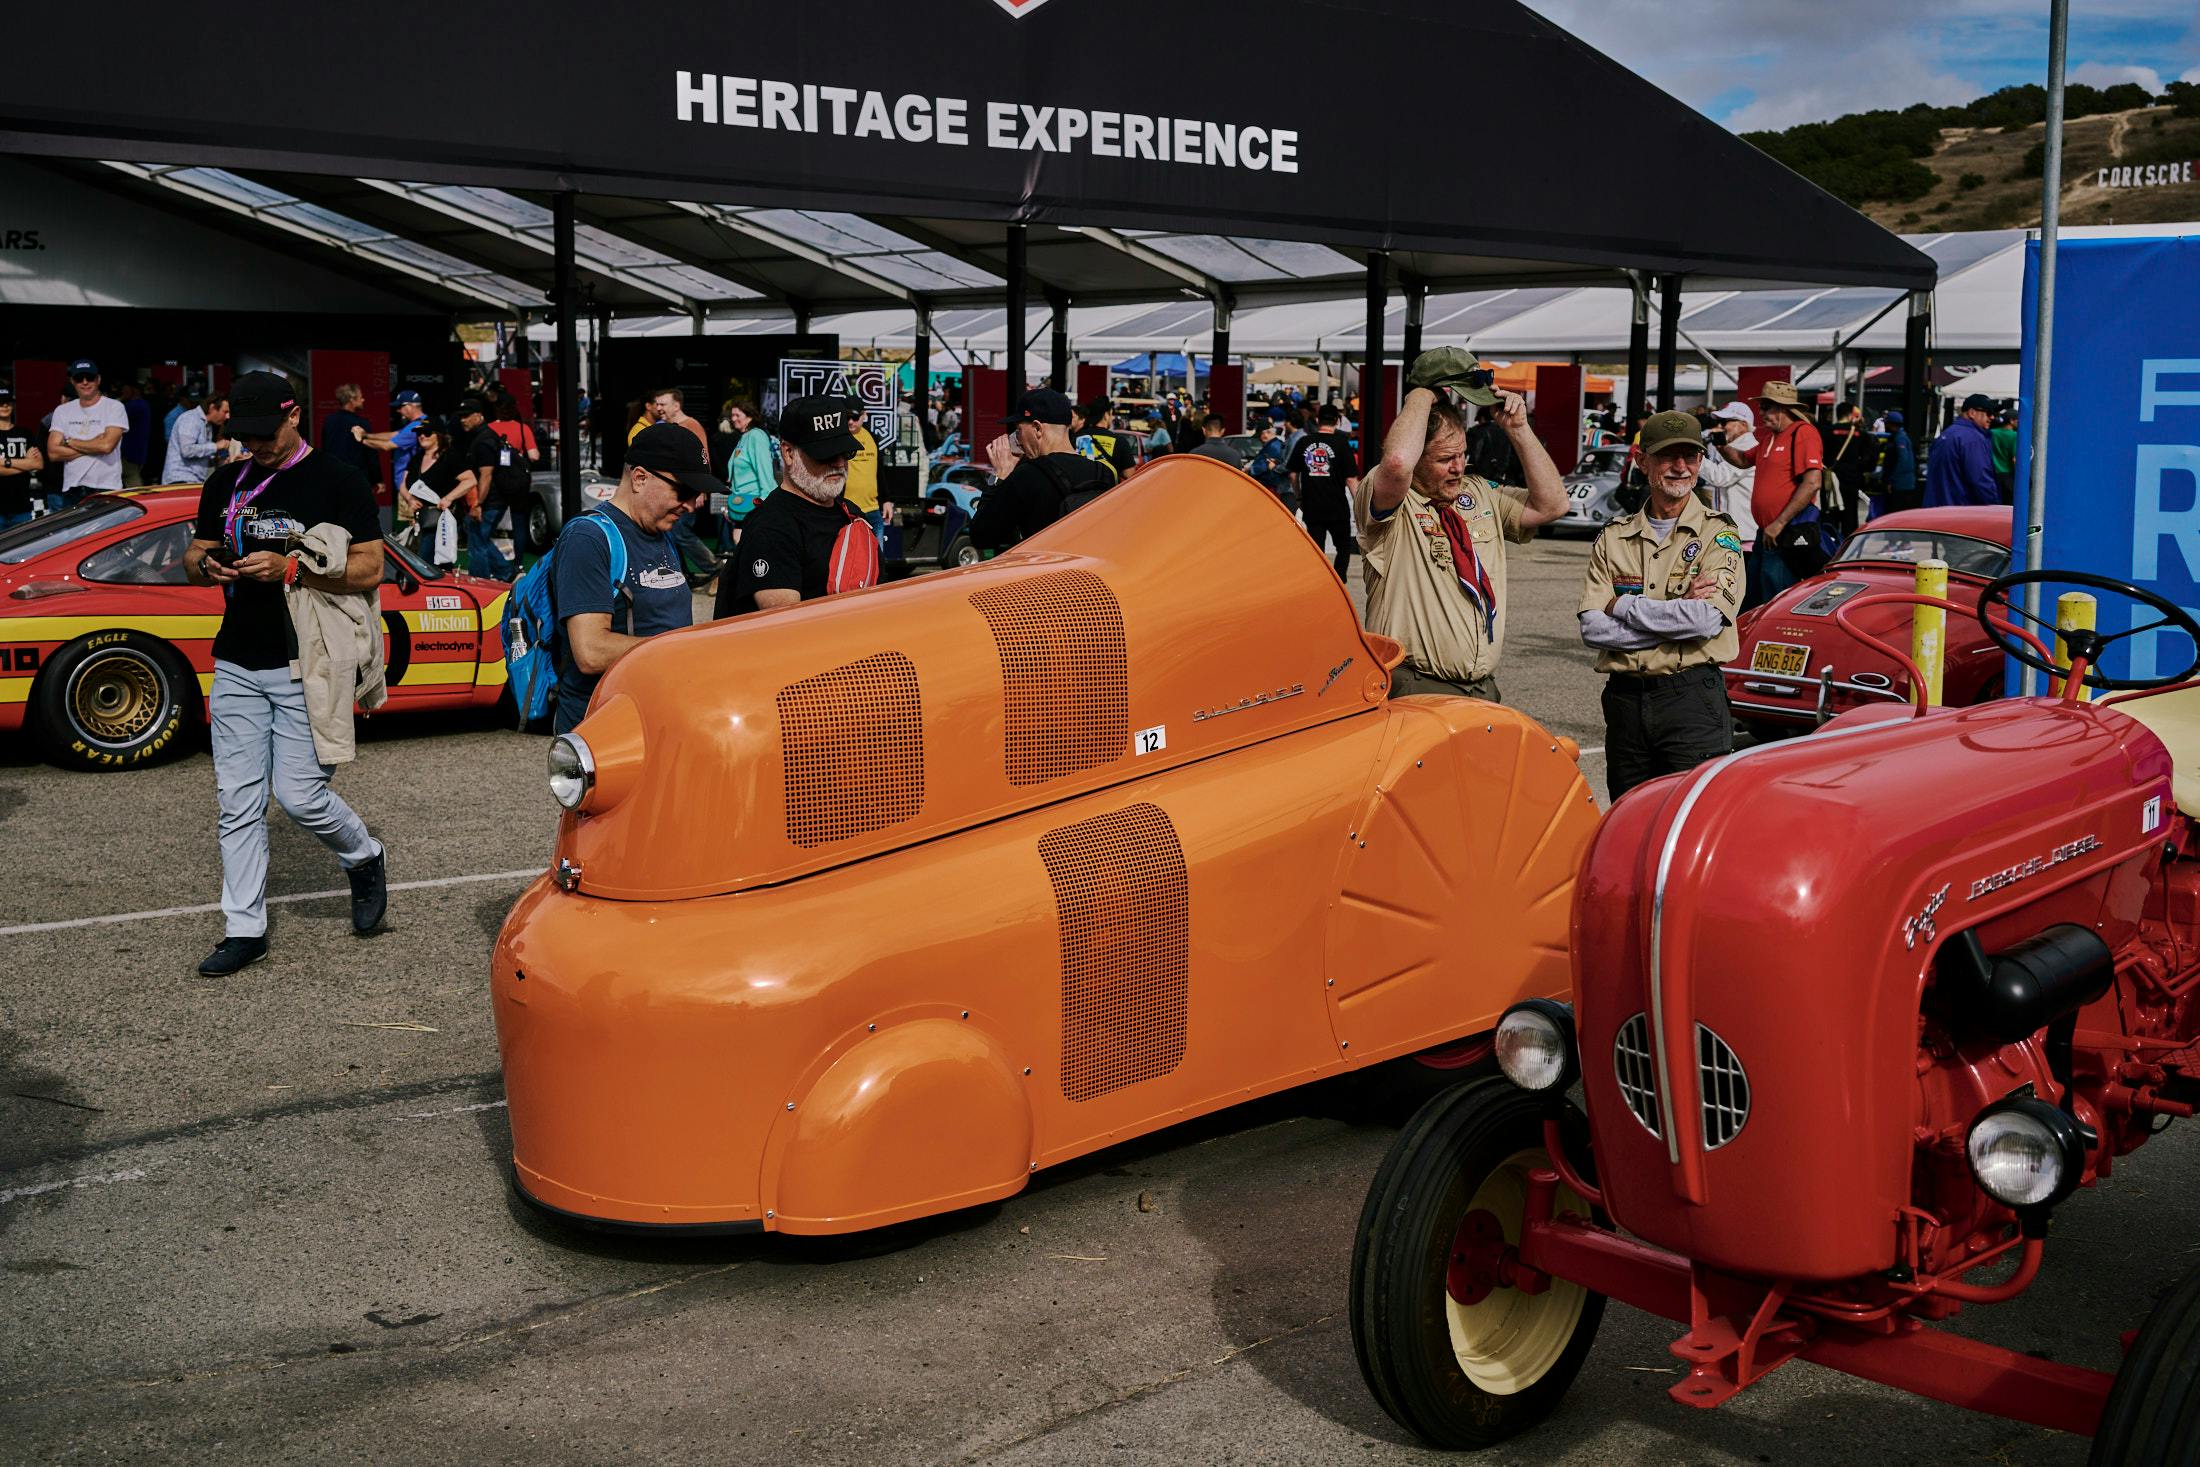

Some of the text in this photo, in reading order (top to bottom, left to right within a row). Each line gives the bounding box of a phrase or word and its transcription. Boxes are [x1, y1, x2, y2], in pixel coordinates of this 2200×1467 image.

[677, 70, 1298, 173] HERITAGE EXPERIENCE
[2098, 161, 2200, 188] CORKSCRE
[0, 230, 46, 250] RS.
[791, 368, 886, 404] TAG
[813, 411, 842, 432] RR7
[1566, 484, 1592, 499] 46
[418, 612, 470, 632] Winston
[88, 633, 128, 650] EAGLE
[415, 641, 475, 652] electrodyne
[1754, 651, 1780, 669] ANG
[1781, 655, 1804, 672] 816
[1142, 732, 1159, 753] 12
[2148, 804, 2156, 830] 11
